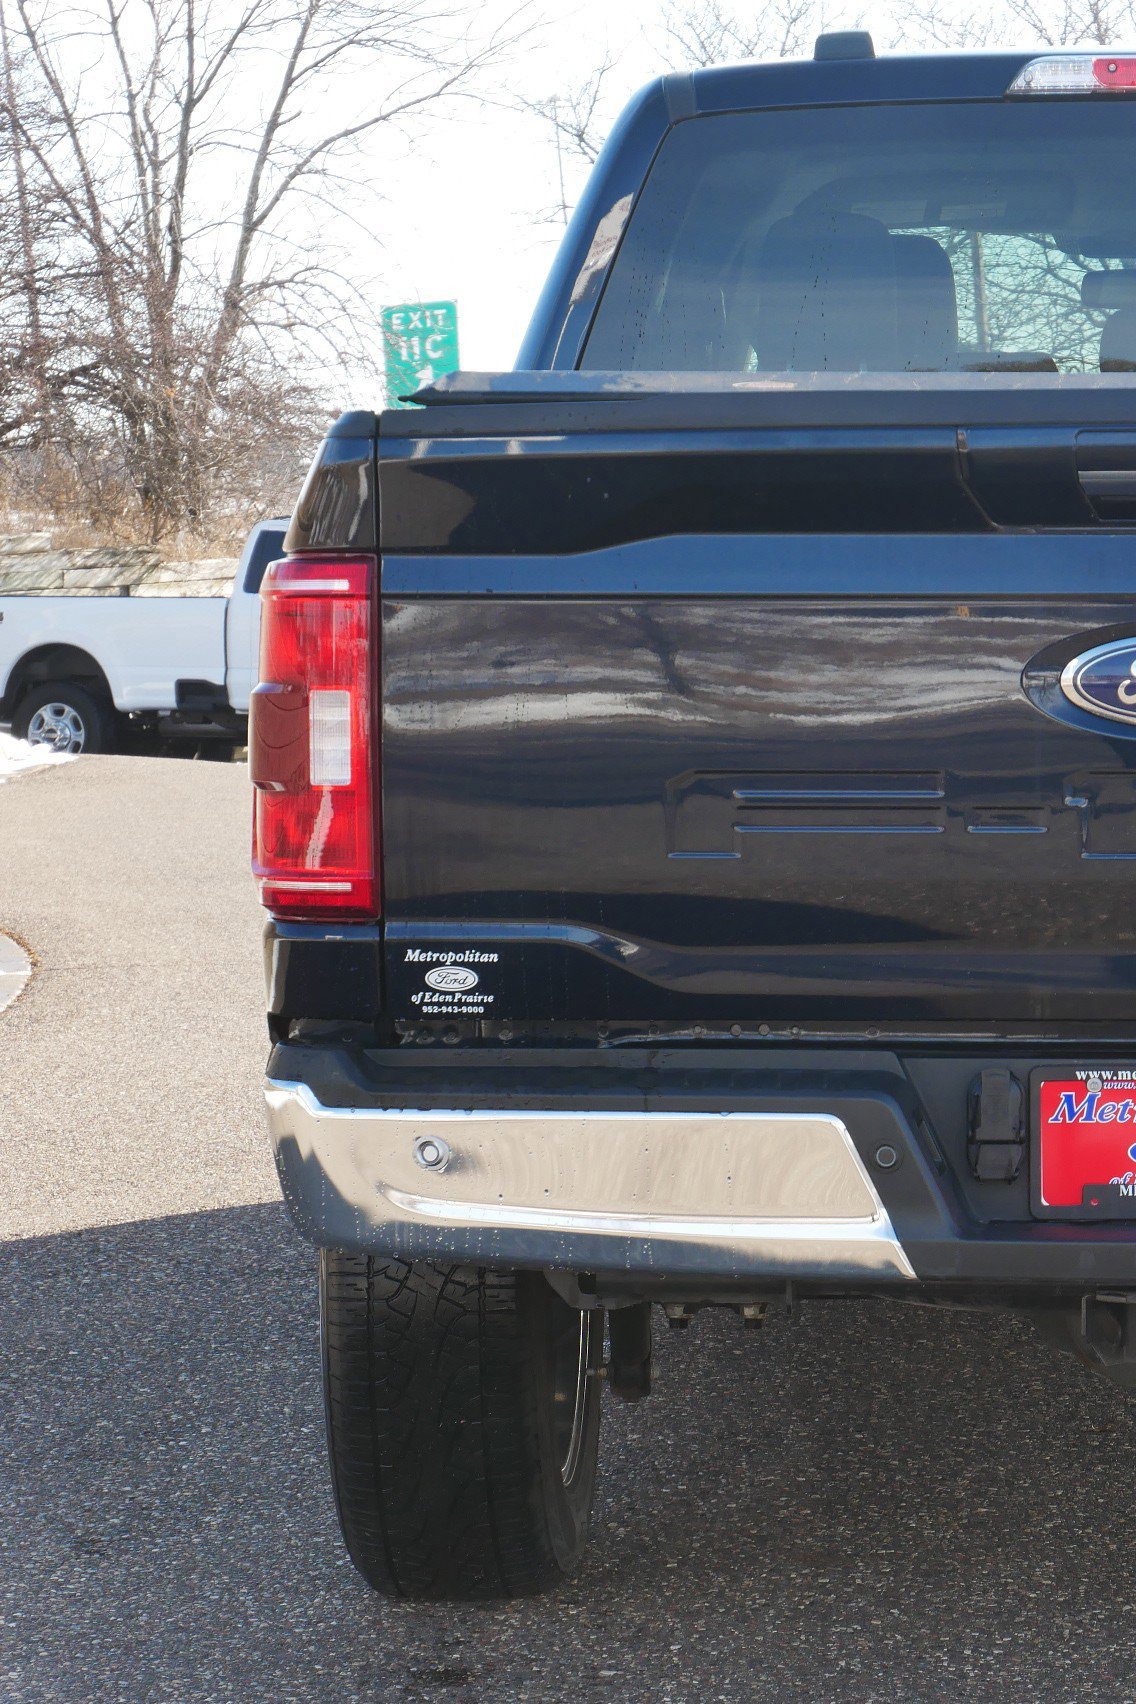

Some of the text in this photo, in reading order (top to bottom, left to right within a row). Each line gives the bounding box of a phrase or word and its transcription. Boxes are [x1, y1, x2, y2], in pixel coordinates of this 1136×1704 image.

[391, 309, 447, 330] EXIT
[398, 334, 444, 361] 11C
[404, 949, 499, 965] Metropolitan
[434, 971, 469, 985] Ford
[411, 991, 495, 1004] of Eden Prairie
[421, 1005, 485, 1013] 952-943-9000
